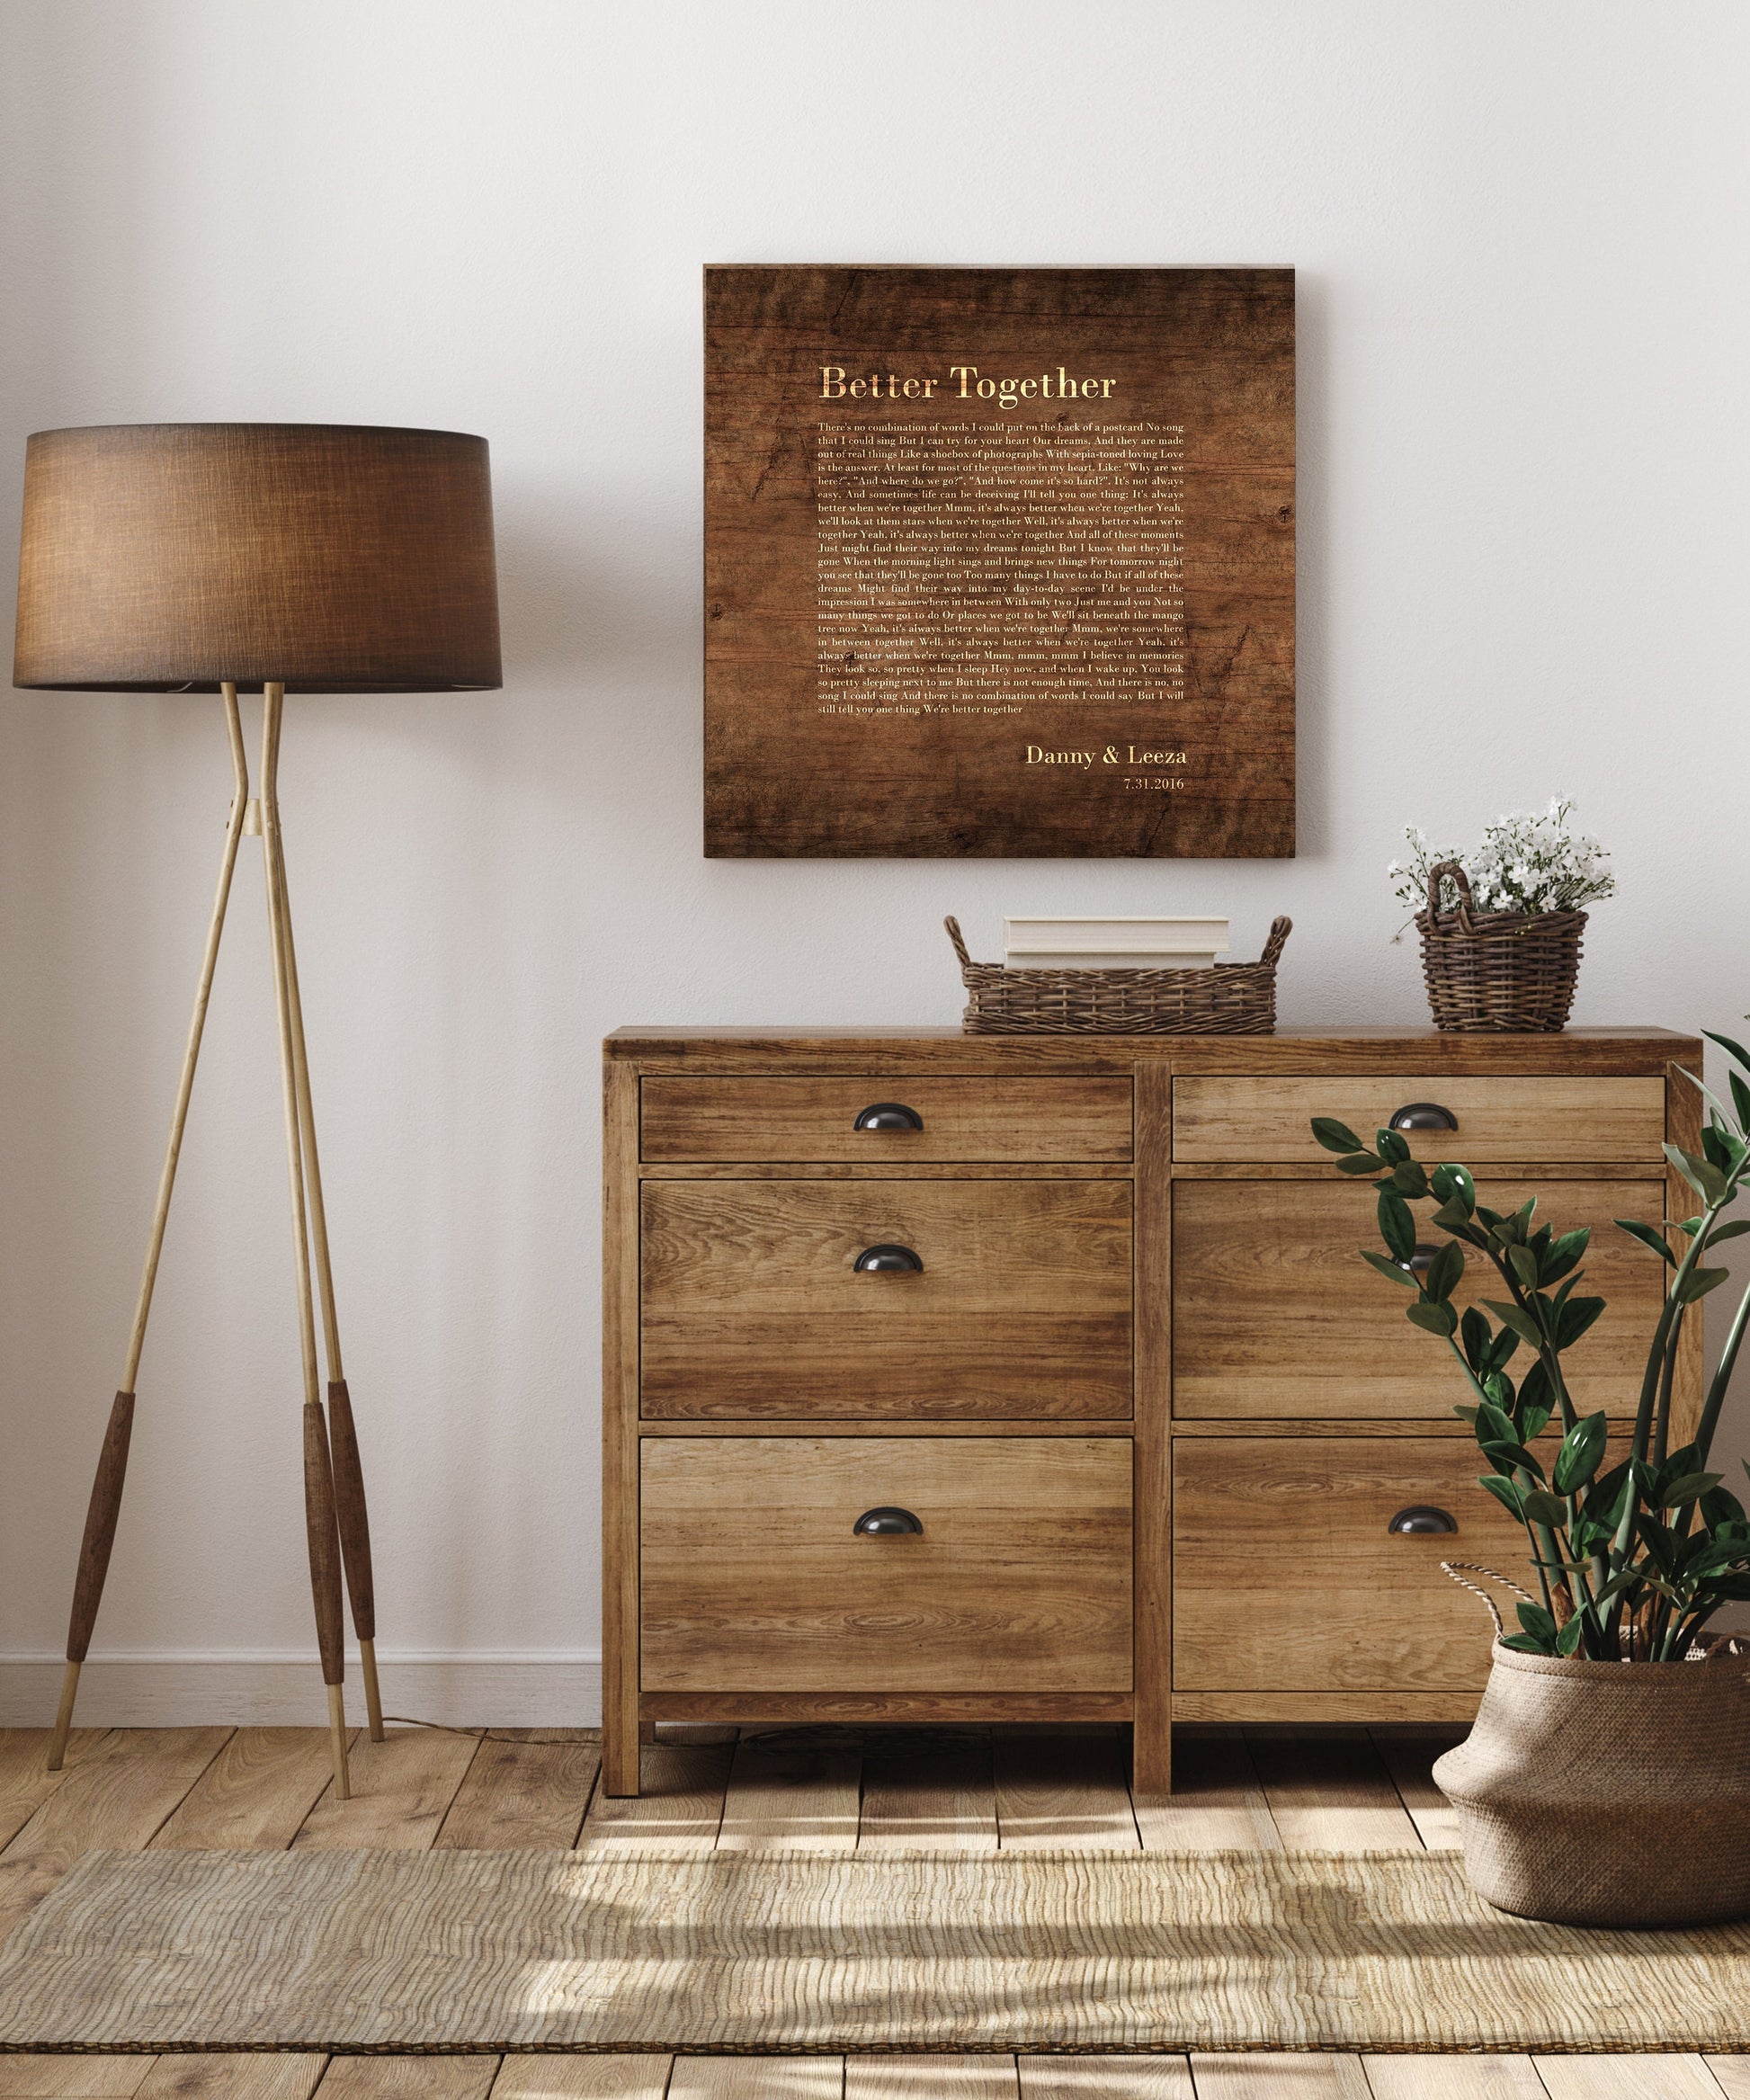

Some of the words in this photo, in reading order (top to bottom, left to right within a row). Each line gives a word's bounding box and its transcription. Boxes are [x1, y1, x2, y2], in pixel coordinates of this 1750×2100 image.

[818, 366, 938, 398] Better
[950, 366, 1117, 410] Together
[817, 422, 852, 432] There's
[868, 422, 927, 432] combination
[929, 422, 941, 432] of
[941, 422, 969, 432] words
[971, 422, 976, 432] I
[978, 422, 1004, 432] could
[1007, 424, 1022, 433] put
[1040, 422, 1056, 432] the
[1058, 422, 1080, 432] back
[1083, 422, 1094, 432] of
[1103, 422, 1143, 433] postcard
[1146, 422, 1160, 432] No
[1162, 424, 1184, 433] song
[817, 451, 833, 459] out
[835, 449, 847, 459] of
[847, 449, 865, 459] real
[868, 449, 897, 460] things
[900, 449, 921, 459] Like
[931, 449, 969, 459] shoebox
[972, 449, 983, 459] of
[984, 449, 1043, 460] photographs
[1046, 449, 1069, 459] With
[1071, 449, 1126, 460] sepia-toned
[1128, 449, 1158, 460] loving
[1160, 449, 1184, 459] Love
[817, 516, 839, 525] we'll
[841, 516, 862, 525] look
[863, 517, 873, 525] at
[876, 516, 900, 525] them
[902, 517, 925, 525] stars
[928, 516, 952, 525] when
[955, 516, 979, 525] we're
[982, 516, 1022, 528] together
[1050, 516, 1065, 525] it's
[1067, 516, 1100, 528] always
[1102, 516, 1130, 525] better
[1132, 516, 1157, 525] when
[1160, 516, 1184, 525] we're
[817, 543, 838, 552] Just
[842, 543, 870, 555] might
[873, 543, 891, 552] find
[895, 543, 918, 552] their
[920, 546, 941, 555] way
[943, 543, 962, 552] into
[966, 546, 980, 555] my
[983, 543, 1018, 552] dreams
[1021, 543, 1055, 555] tonight
[1059, 543, 1076, 552] But
[1080, 543, 1085, 552] I
[1088, 543, 1113, 552] know
[1117, 543, 1137, 552] that
[1140, 543, 1170, 555] they'll
[1173, 543, 1184, 552] be
[817, 559, 840, 568] gone
[843, 557, 871, 566] When
[873, 557, 889, 566] the
[891, 557, 932, 568] morning
[933, 557, 955, 568] light
[958, 557, 982, 568] sings
[984, 557, 1002, 566] and
[1004, 557, 1034, 568] brings
[1058, 557, 1087, 568] things
[1091, 557, 1108, 566] For
[1110, 558, 1156, 566] tomorrow
[1158, 557, 1184, 568] night
[817, 583, 852, 593] dreams
[858, 583, 885, 594] Might
[891, 583, 910, 593] find
[915, 583, 938, 593] their
[943, 585, 963, 594] way
[969, 583, 987, 593] into
[993, 585, 1008, 594] my
[1013, 583, 1066, 594] day-to-day
[1102, 583, 1114, 593] I'd
[1120, 583, 1130, 593] be
[1136, 583, 1164, 593] under
[1168, 583, 1183, 593] the
[817, 596, 869, 608] impression
[871, 596, 875, 606] I
[897, 596, 950, 606] somewhere
[951, 596, 960, 606] in
[963, 596, 1002, 606] between
[1004, 596, 1029, 606] With
[1031, 596, 1051, 608] only
[1054, 598, 1072, 606] two
[1074, 596, 1094, 606] Just
[1113, 596, 1130, 606] and
[1133, 599, 1151, 608] you
[1154, 596, 1171, 606] Not
[817, 612, 844, 621] many
[848, 610, 878, 621] things
[896, 612, 911, 621] got
[915, 612, 924, 620] to
[927, 610, 940, 620] do
[942, 610, 955, 620] Or
[958, 610, 987, 621] places
[1005, 612, 1020, 621] got
[1024, 612, 1034, 620] to
[1037, 610, 1049, 620] be
[1051, 610, 1075, 620] We'll
[1077, 610, 1090, 620] sit
[1093, 610, 1130, 620] beneath
[1134, 610, 1149, 620] the
[1152, 612, 1184, 621] mango
[817, 693, 840, 702] song
[843, 691, 847, 700] I
[850, 691, 876, 700] could
[879, 691, 898, 702] sing
[901, 691, 921, 700] And
[924, 691, 949, 700] there
[951, 691, 959, 700] is
[976, 691, 1035, 700] combination
[1038, 691, 1049, 700] of
[1050, 691, 1079, 700] words
[1082, 691, 1086, 700] I
[1089, 691, 1115, 700] could
[1118, 693, 1134, 702] say
[1138, 691, 1155, 700] But
[1158, 691, 1163, 700] I
[1166, 691, 1183, 700] will
[817, 704, 835, 713] still
[838, 704, 853, 713] tell
[855, 707, 873, 716] you
[896, 704, 921, 716] thing
[923, 704, 950, 713] We're
[952, 704, 981, 713] better
[983, 704, 1023, 716] together
[1025, 746, 1097, 770] Danny
[1103, 745, 1121, 764] &
[1127, 745, 1187, 764] Leeza
[1123, 778, 1184, 790] 7.31.2016
